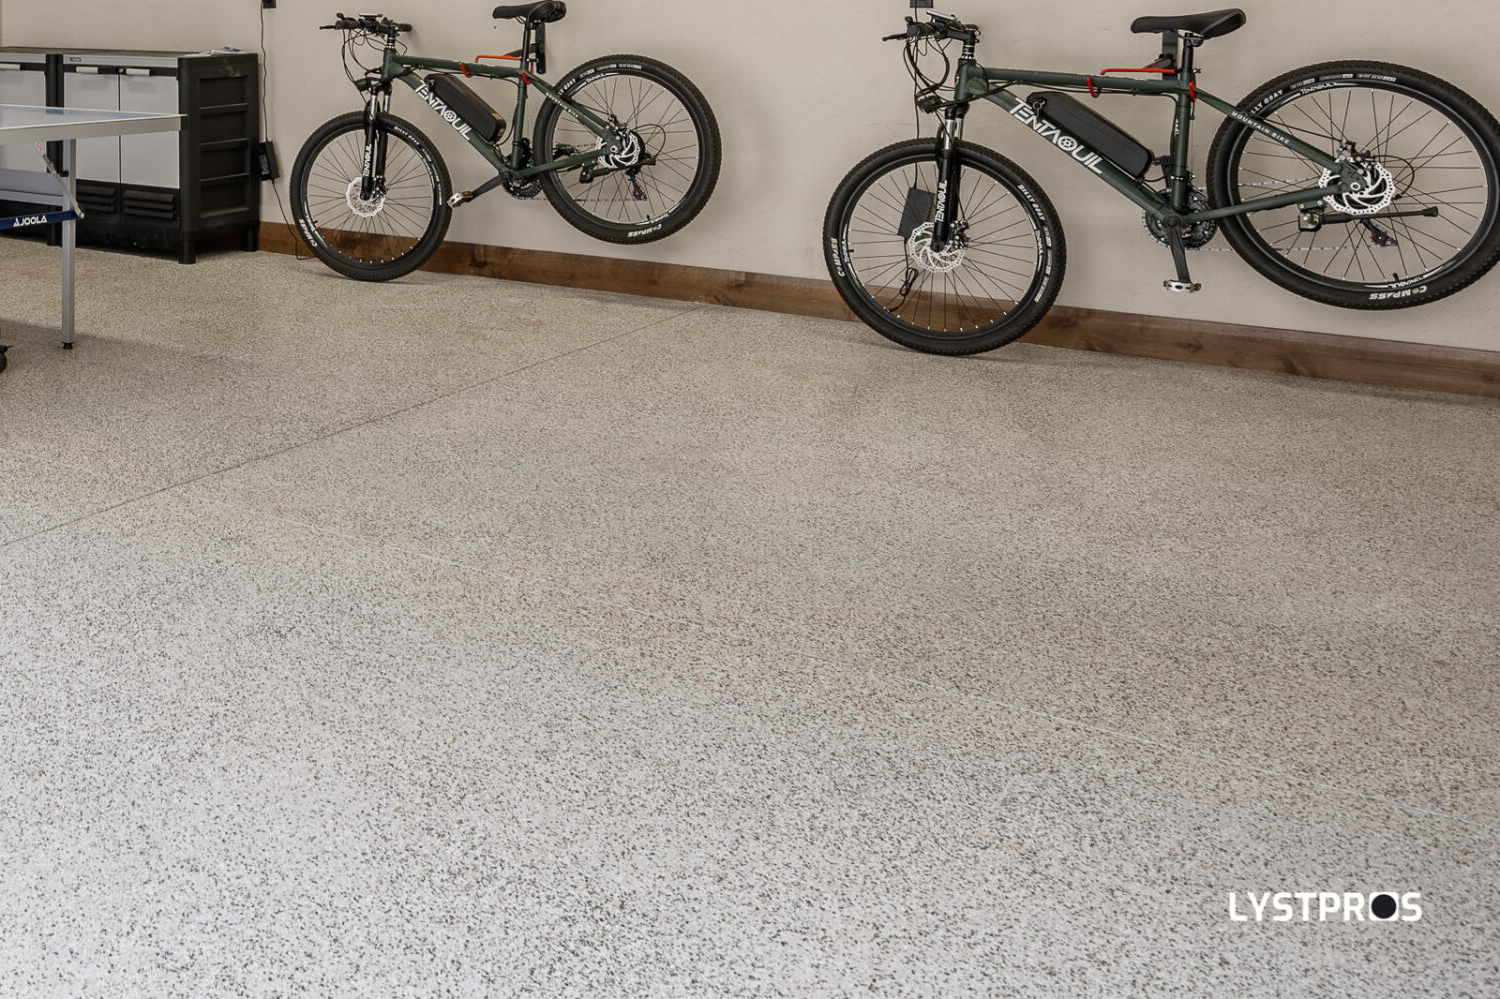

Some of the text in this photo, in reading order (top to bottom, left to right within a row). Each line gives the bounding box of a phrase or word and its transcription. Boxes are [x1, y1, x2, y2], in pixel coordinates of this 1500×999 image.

[415, 80, 472, 140] TENTAQUIL
[1010, 97, 1102, 174] TENTAQUIL
[21, 215, 48, 226] JOOLA
